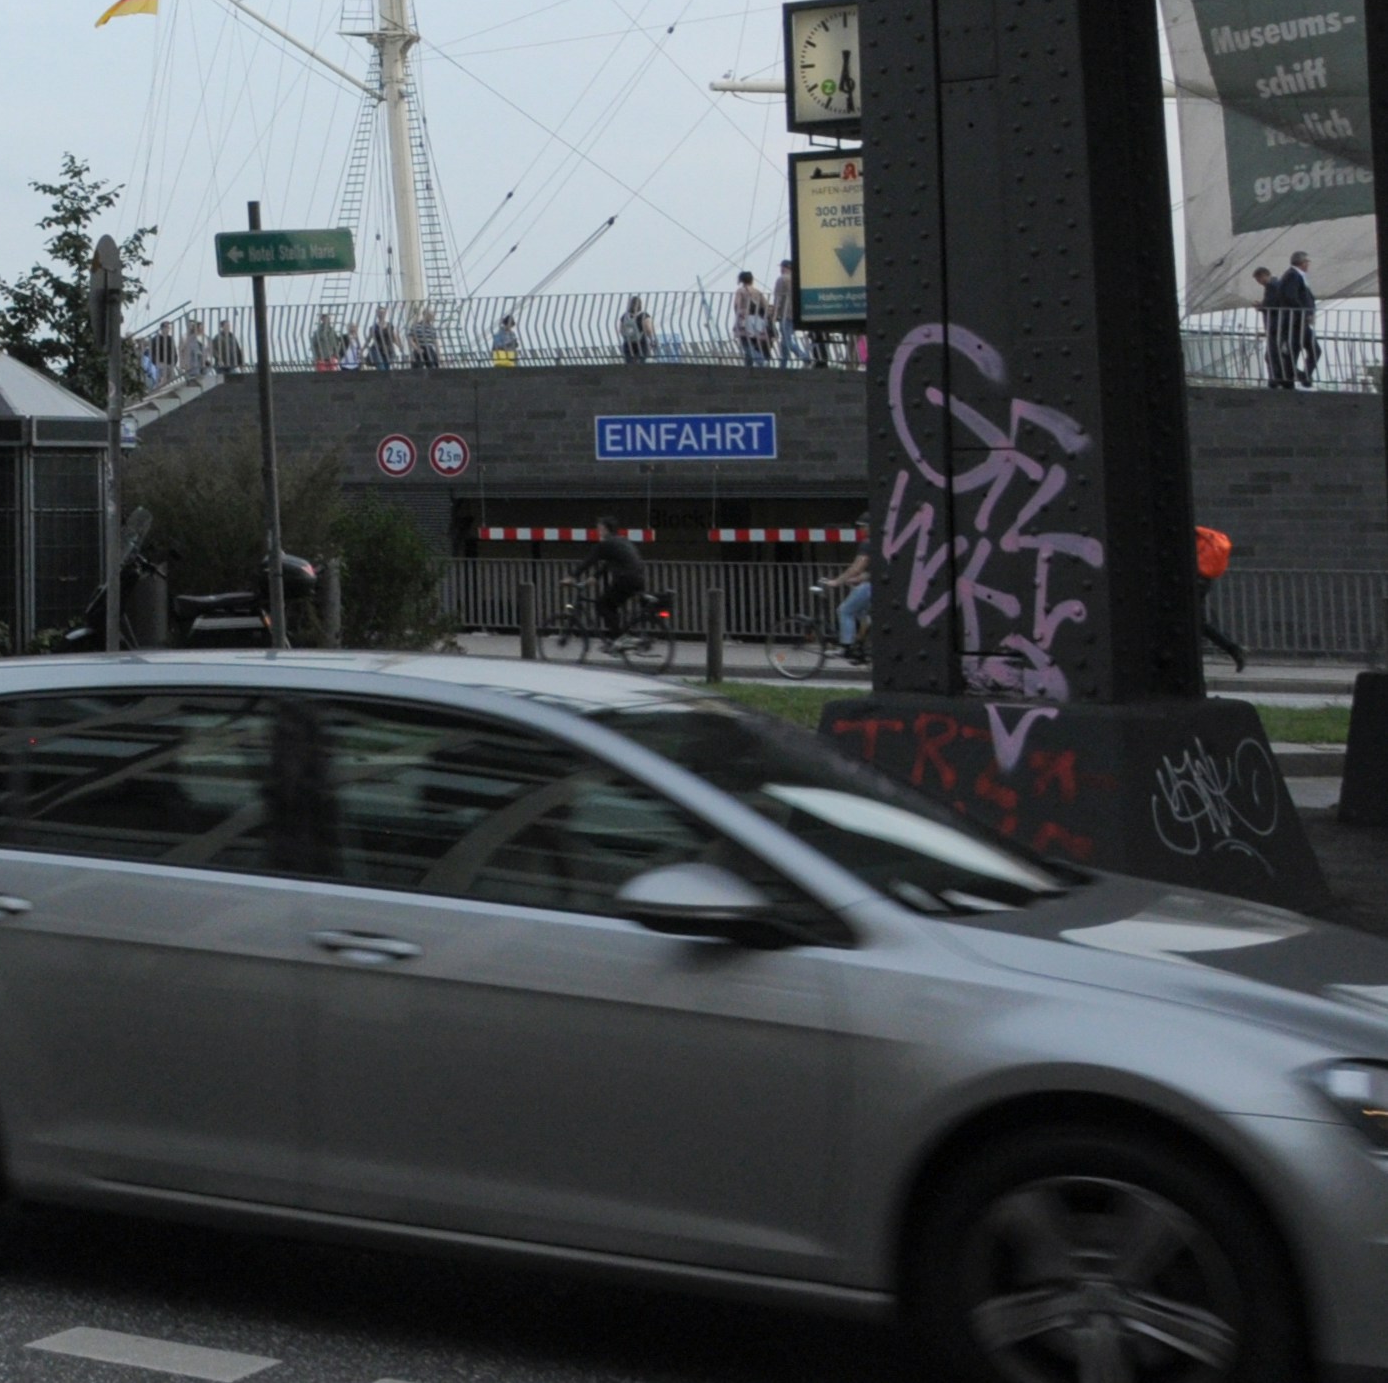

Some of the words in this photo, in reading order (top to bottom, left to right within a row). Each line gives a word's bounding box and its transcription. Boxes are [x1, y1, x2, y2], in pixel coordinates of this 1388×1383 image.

[1210, 12, 1356, 55] Museums-
[1256, 57, 1327, 98] schiff
[816, 206, 837, 216] 300
[248, 245, 274, 262] Hotel
[279, 243, 305, 260] Stella
[310, 241, 335, 258] Maris
[605, 422, 765, 451] EINFAHRT
